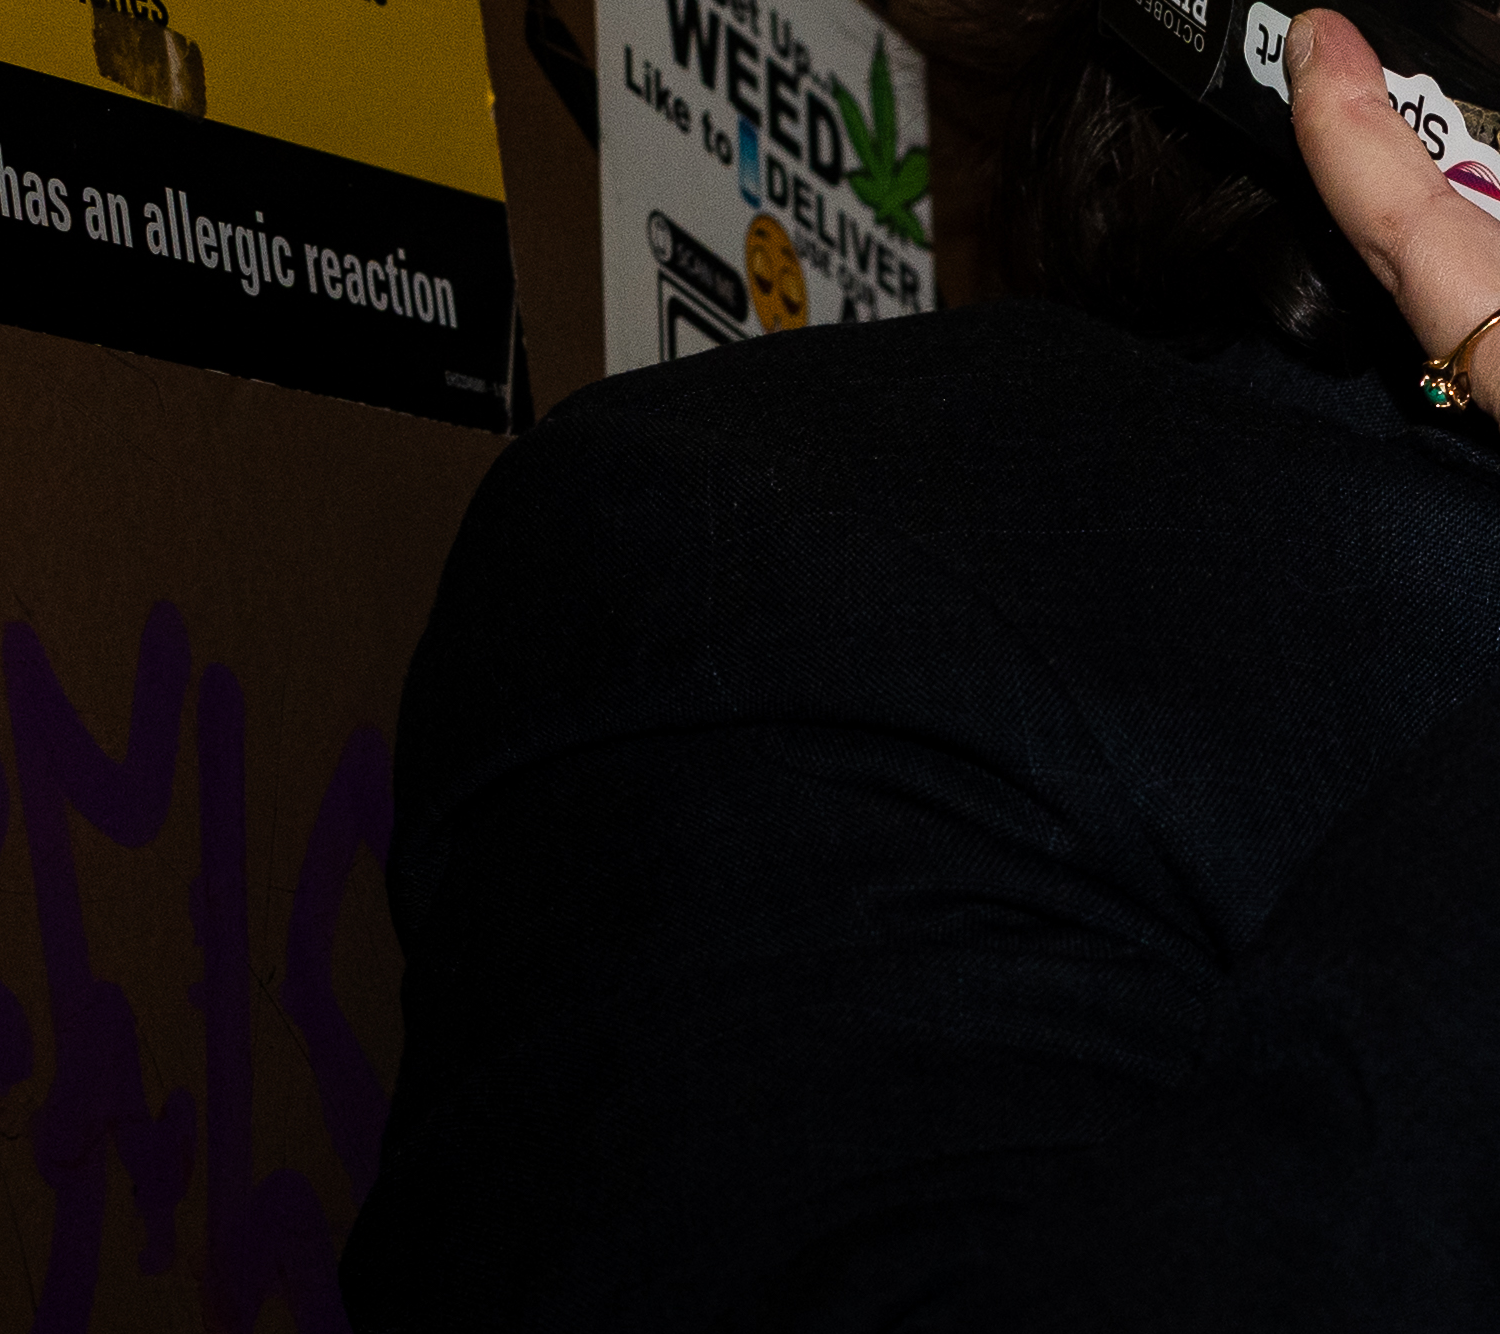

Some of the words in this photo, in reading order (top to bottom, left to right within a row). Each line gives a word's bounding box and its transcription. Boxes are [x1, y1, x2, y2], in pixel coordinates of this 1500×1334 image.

[83, 187, 133, 248] an
[144, 187, 296, 297] allergic
[304, 248, 458, 329] reaction
[624, 44, 690, 133] Like
[703, 110, 733, 167] to
[765, 156, 920, 314] DELIVER
